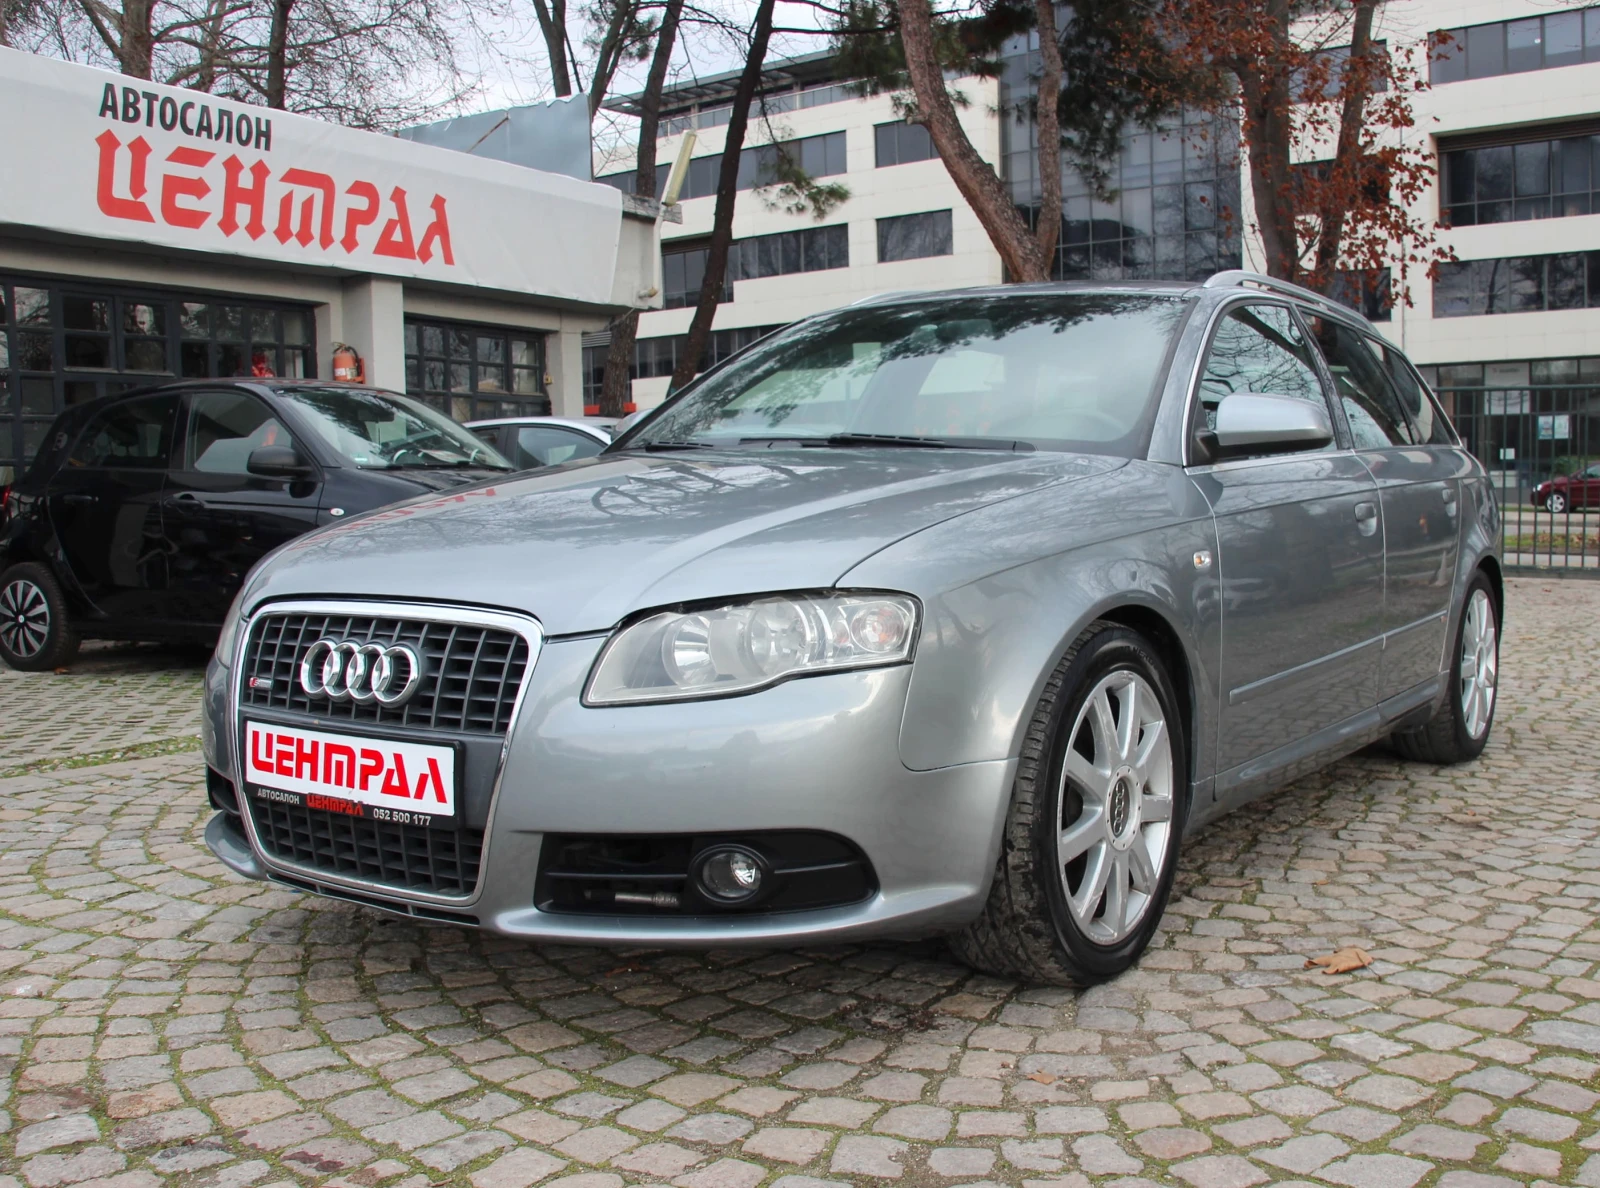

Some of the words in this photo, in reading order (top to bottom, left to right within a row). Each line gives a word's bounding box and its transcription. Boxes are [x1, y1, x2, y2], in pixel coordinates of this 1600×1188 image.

[99, 82, 272, 151] АВТОСАЛОН
[257, 788, 300, 804] АВТОСАЛОН
[373, 808, 390, 820] 052
[392, 811, 410, 823] 500
[413, 813, 431, 825] 177
